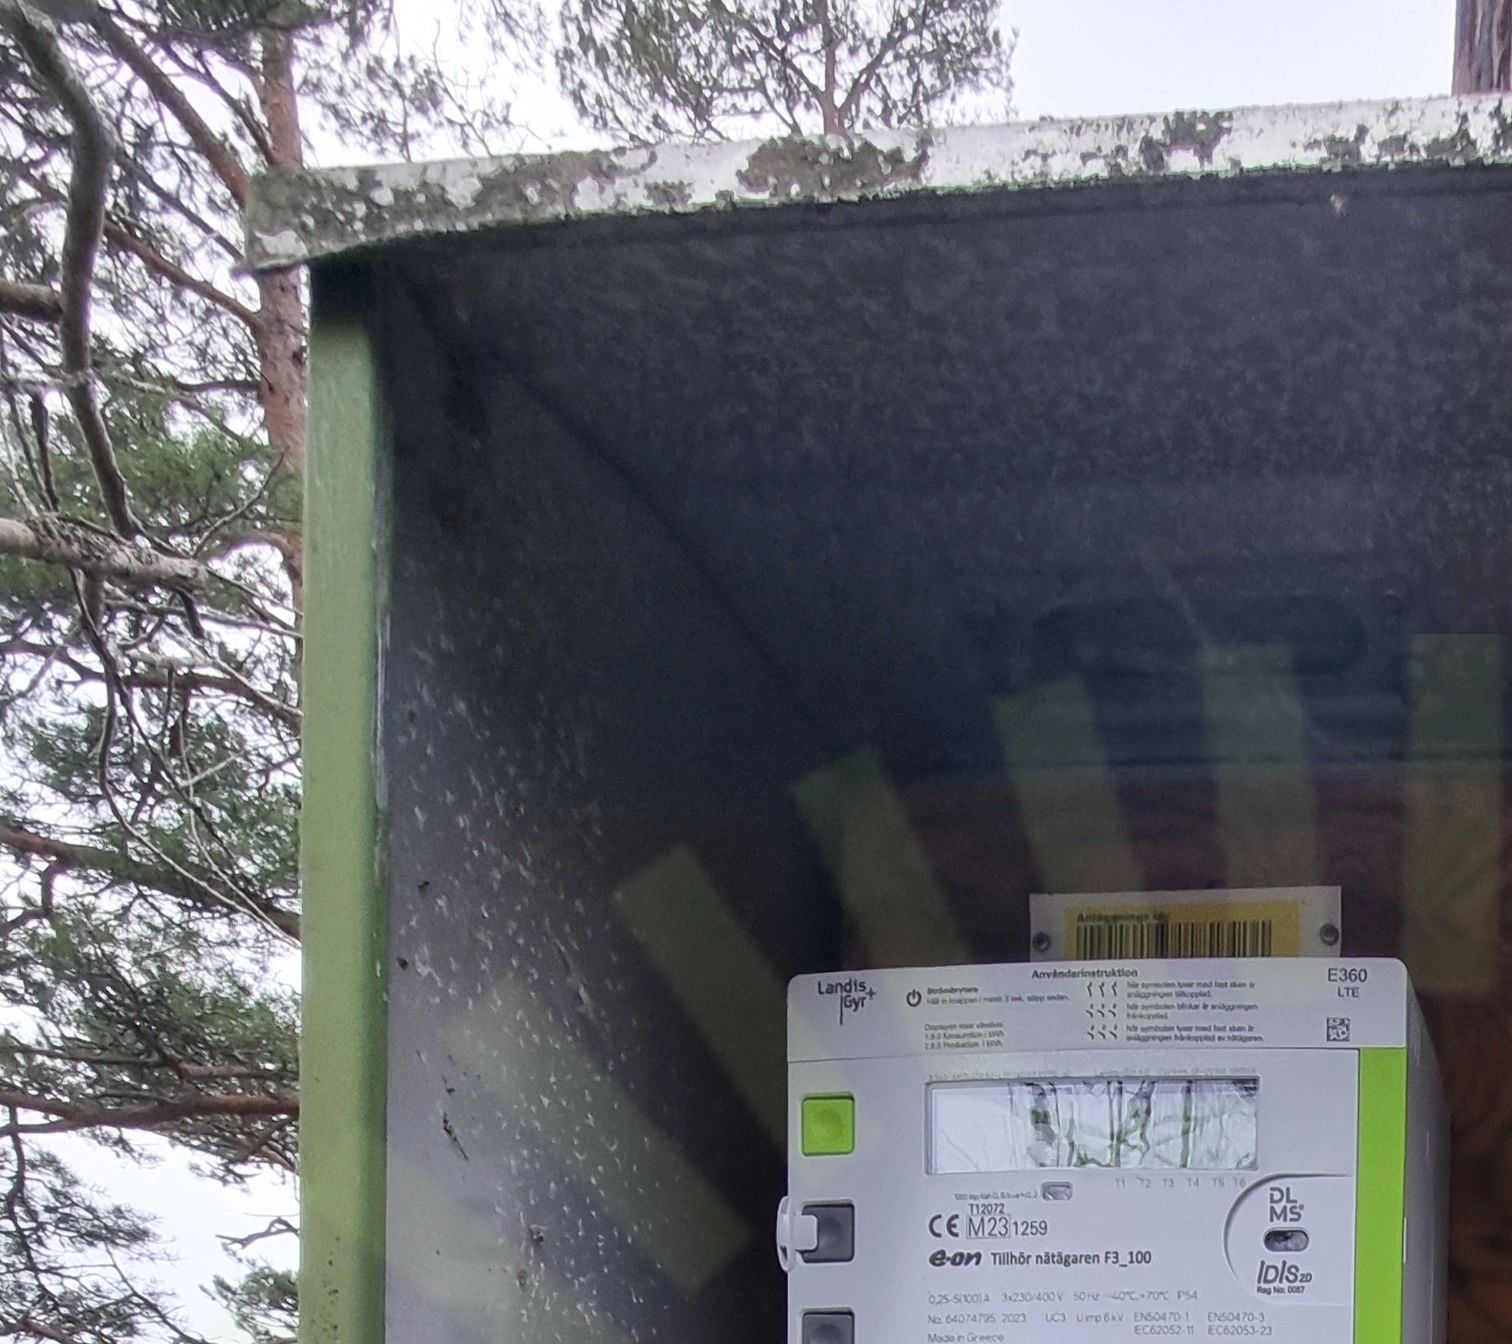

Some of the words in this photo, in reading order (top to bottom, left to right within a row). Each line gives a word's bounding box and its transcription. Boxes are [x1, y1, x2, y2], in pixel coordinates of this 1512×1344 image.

[1327, 968, 1368, 983] E360
[1337, 987, 1359, 998] LTE
[968, 1217, 1009, 1238] M23
[1013, 1221, 1048, 1236] 1259
[1036, 1251, 1100, 1267] nätägaren
[1104, 1251, 1152, 1267] F3_100
